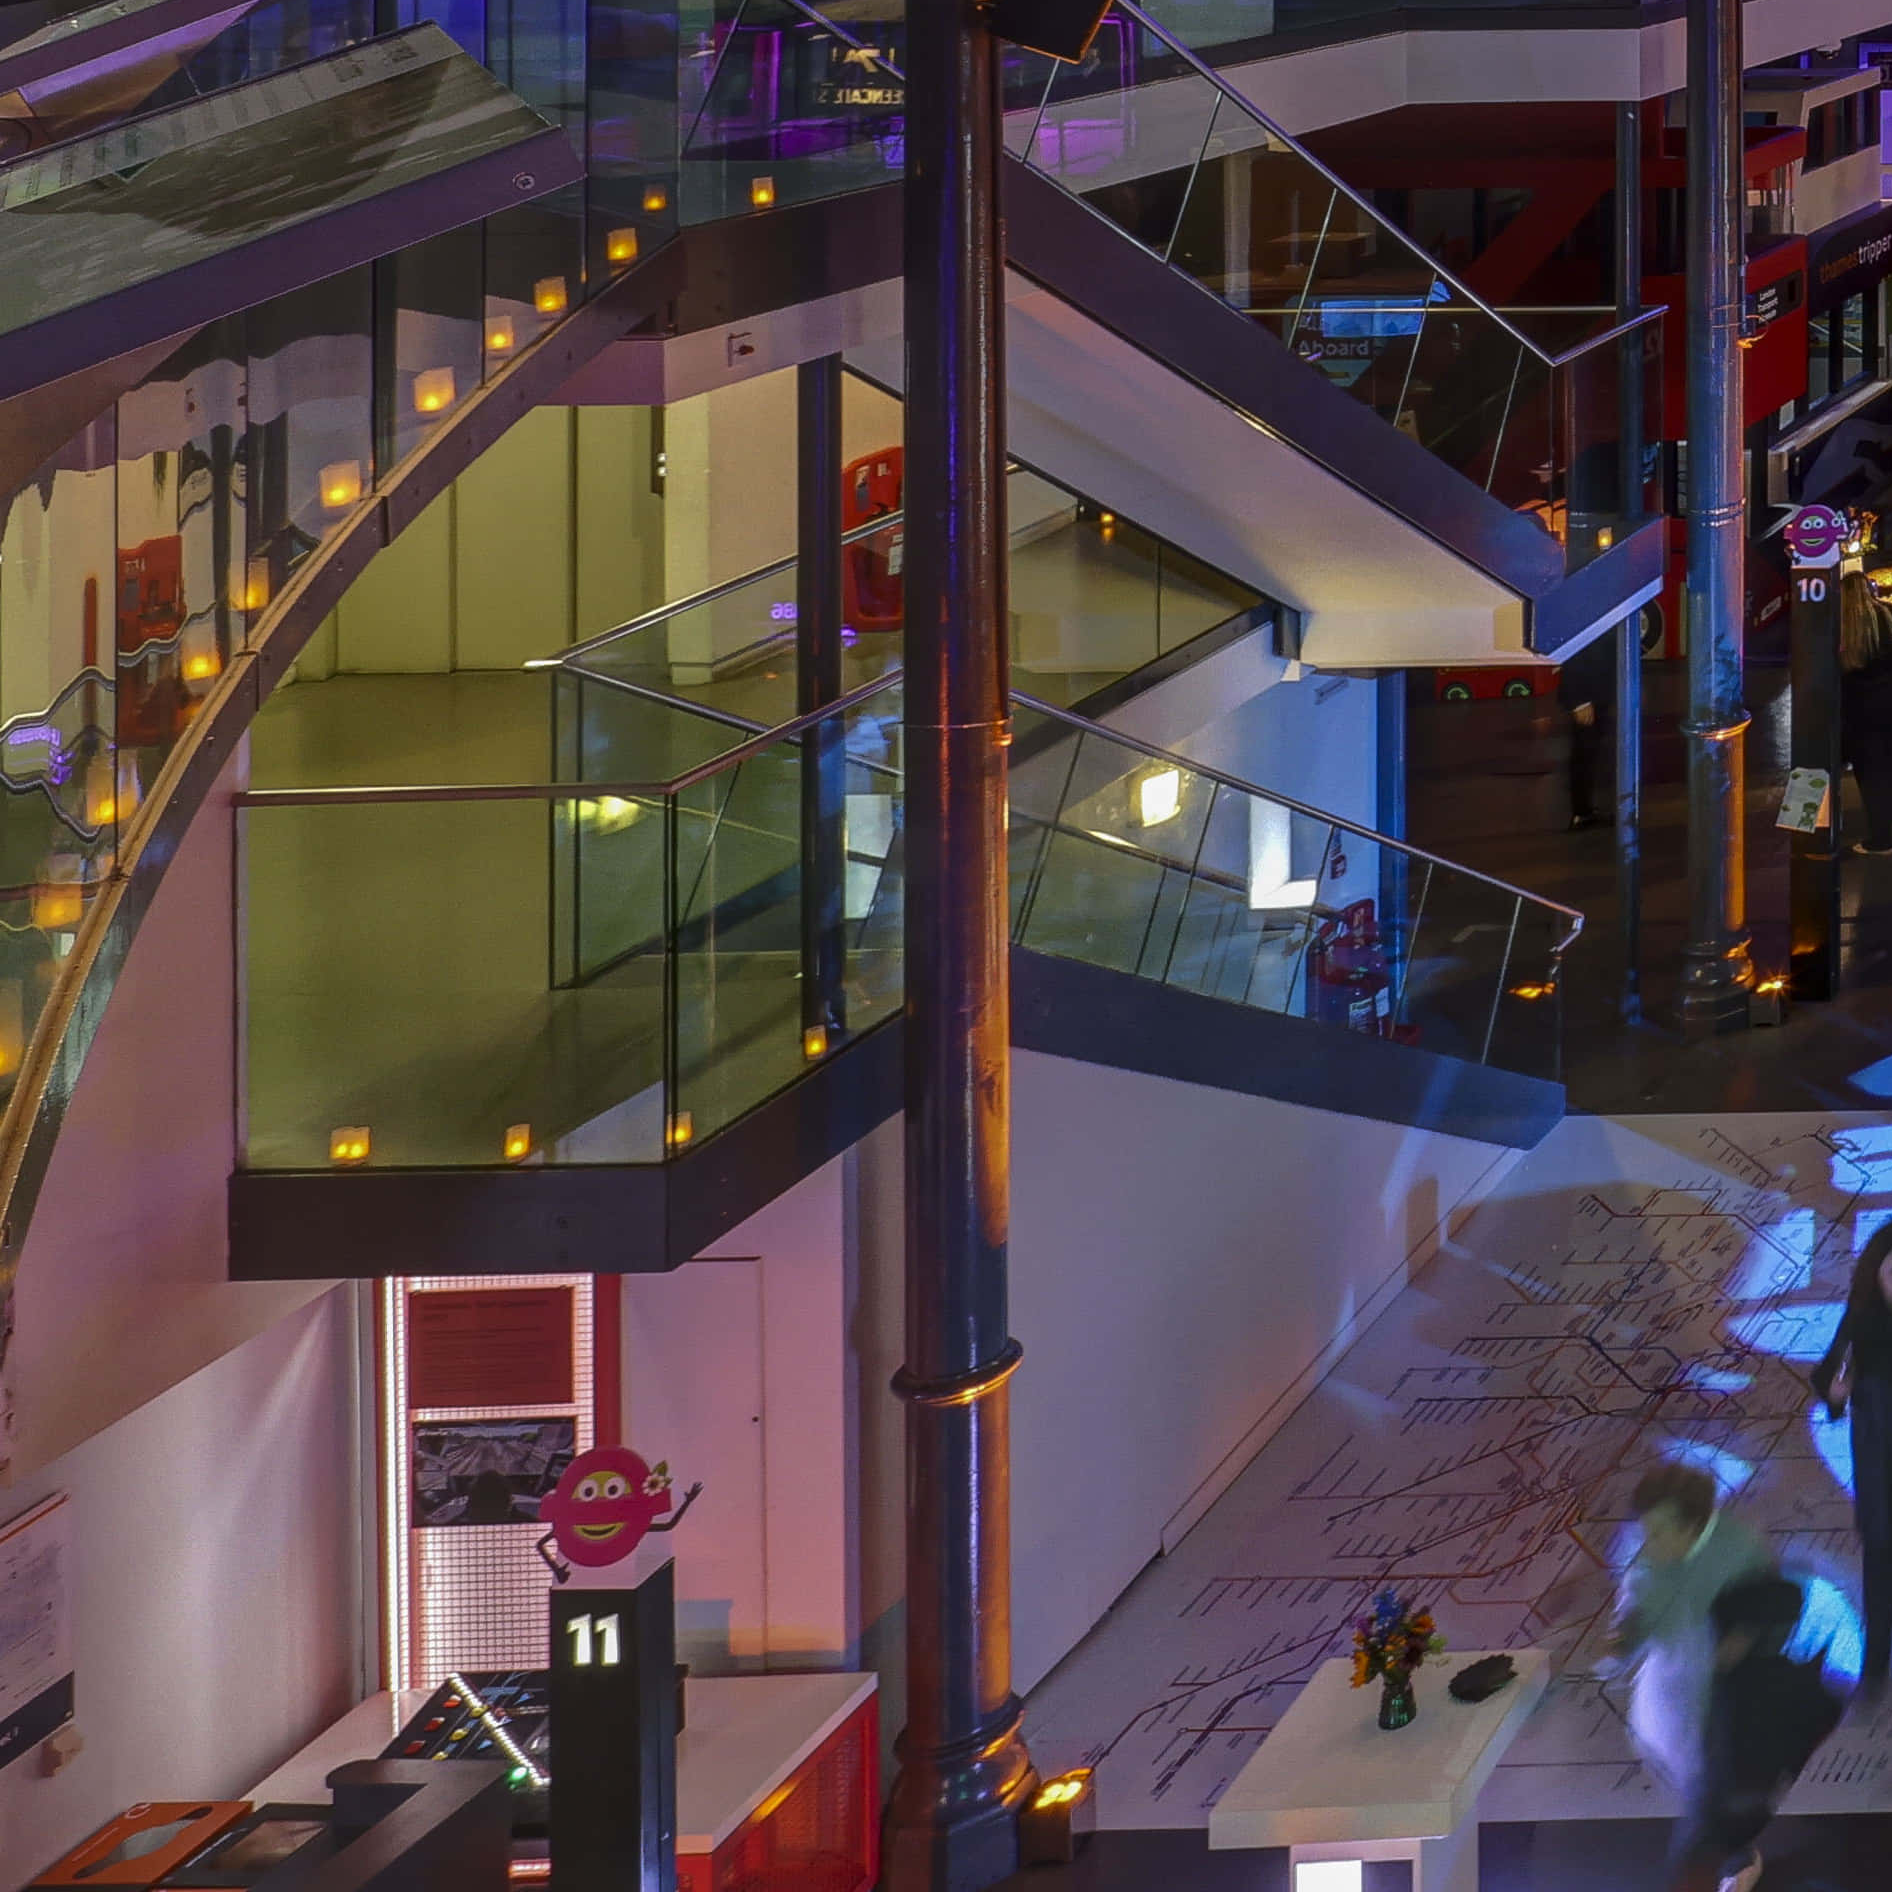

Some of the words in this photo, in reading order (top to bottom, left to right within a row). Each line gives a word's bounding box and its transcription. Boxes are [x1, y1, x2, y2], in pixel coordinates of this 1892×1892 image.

[1298, 340, 1369, 356] Aboard
[1797, 578, 1826, 602] 10
[565, 1612, 620, 1667] 11
